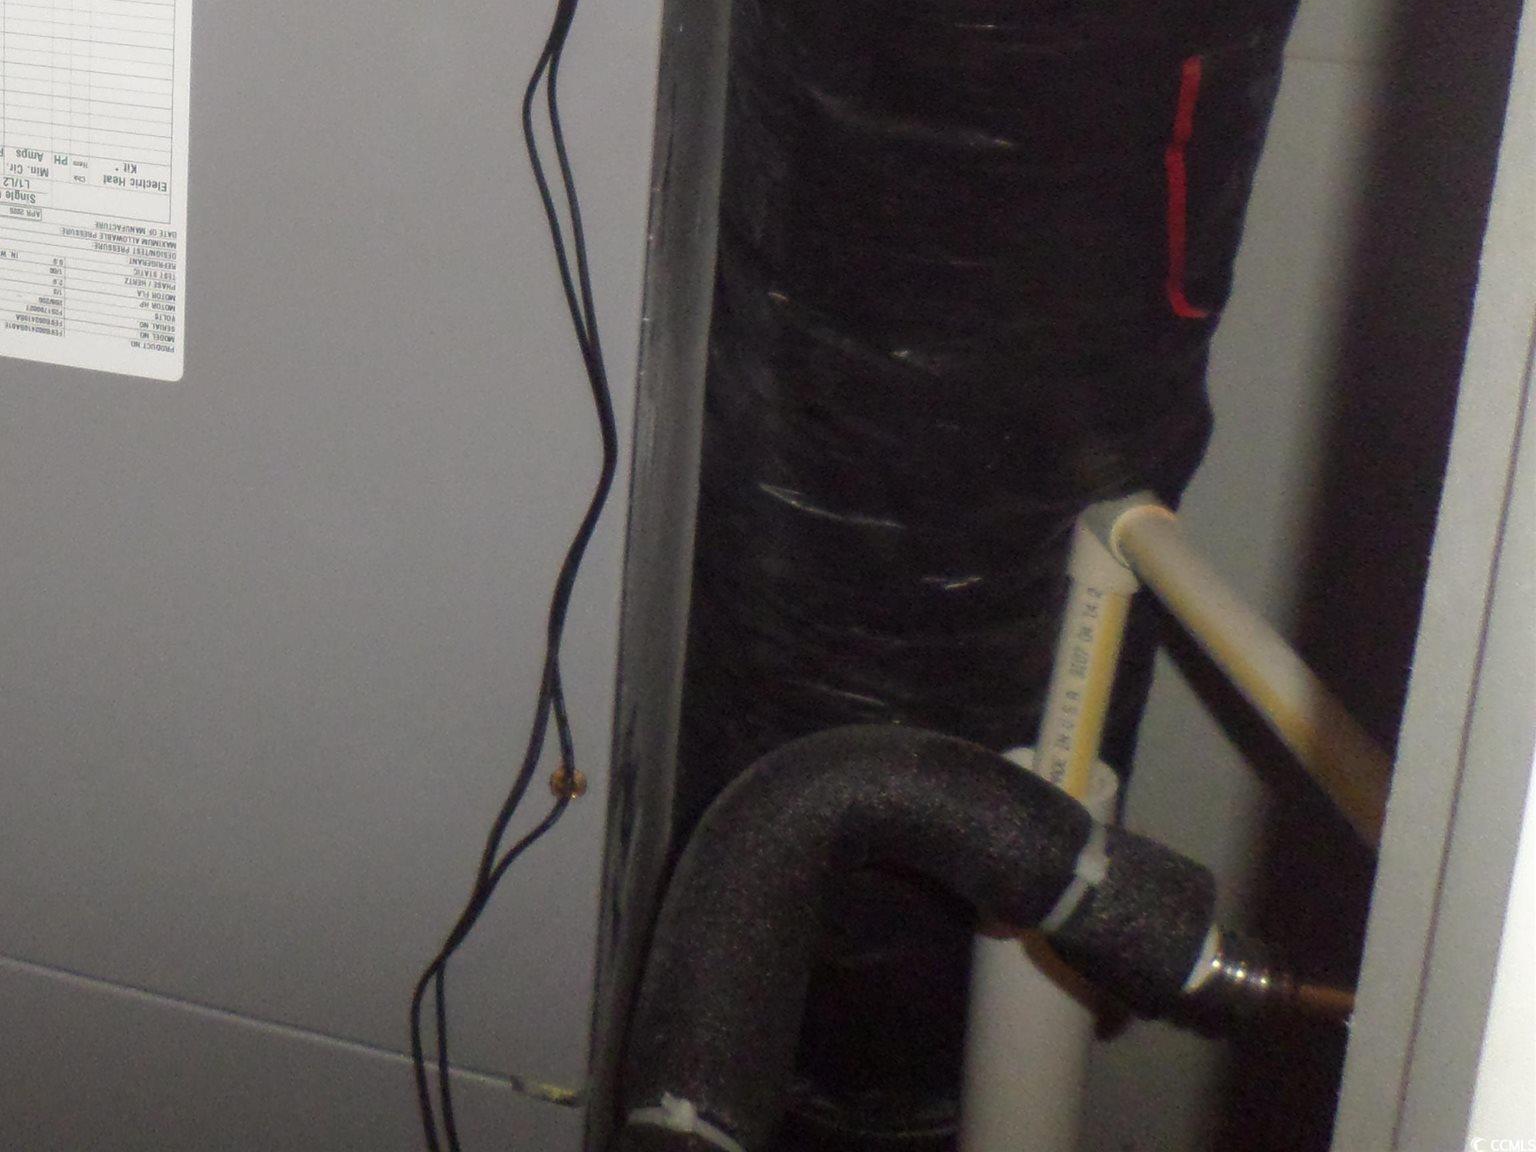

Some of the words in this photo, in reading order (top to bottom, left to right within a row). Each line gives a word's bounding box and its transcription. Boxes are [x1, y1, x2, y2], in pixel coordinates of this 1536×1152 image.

[16, 149, 44, 160] Amps
[54, 155, 68, 165] PH
[27, 166, 48, 177] Min.
[123, 163, 137, 174] Kit
[3, 177, 29, 186] L1/L2
[103, 175, 125, 187] Heat
[130, 178, 167, 192] Electric
[6, 192, 35, 203] Single
[26, 210, 40, 218] APR
[95, 222, 146, 235] MANUFACTURE
[99, 233, 139, 244] ALLOWABLE
[160, 230, 177, 239] DATE
[141, 238, 176, 249] MAXIMUM
[132, 247, 176, 259] DESIGN/TEST
[128, 258, 176, 270] REFRIGERANT
[133, 268, 157, 278] STATIC
[159, 272, 176, 280] TEST
[124, 277, 146, 286] HERTZ
[153, 281, 176, 290] PHASE
[137, 290, 149, 298] FLA
[152, 292, 175, 301] MOTOR
[151, 303, 175, 311] MOTOR
[155, 313, 175, 322] VOLTS
[152, 323, 175, 332] SERIAL
[153, 333, 175, 343] MODEL
[143, 343, 174, 353] PRODUCT
